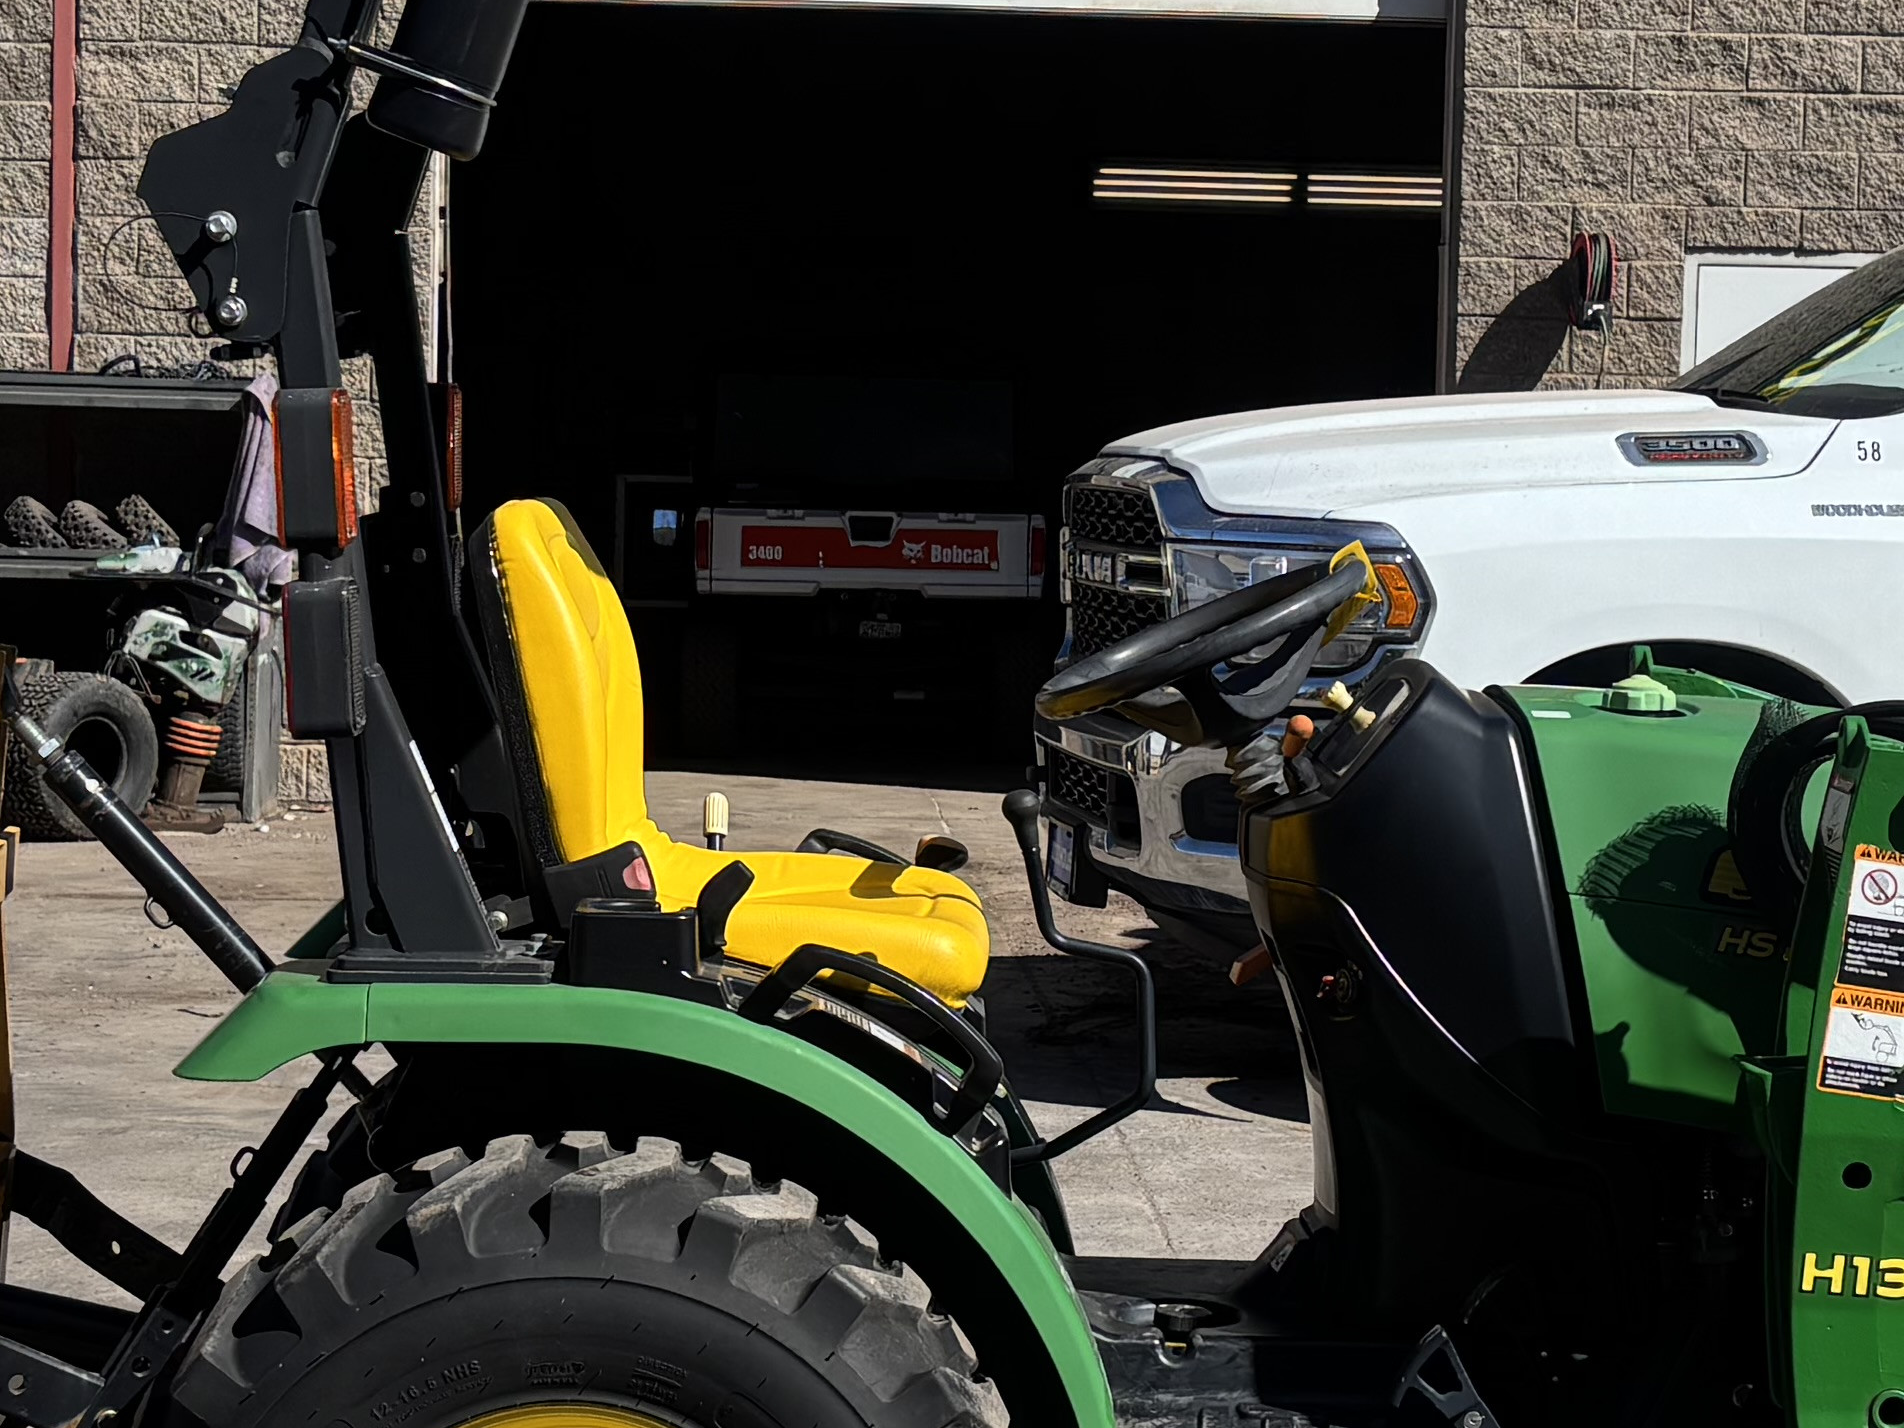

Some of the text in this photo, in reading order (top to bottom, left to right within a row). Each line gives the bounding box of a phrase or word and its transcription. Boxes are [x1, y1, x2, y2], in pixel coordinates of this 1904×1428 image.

[1856, 440, 1882, 463] 58
[930, 544, 990, 565] Bobcat
[442, 1358, 483, 1384] NHS
